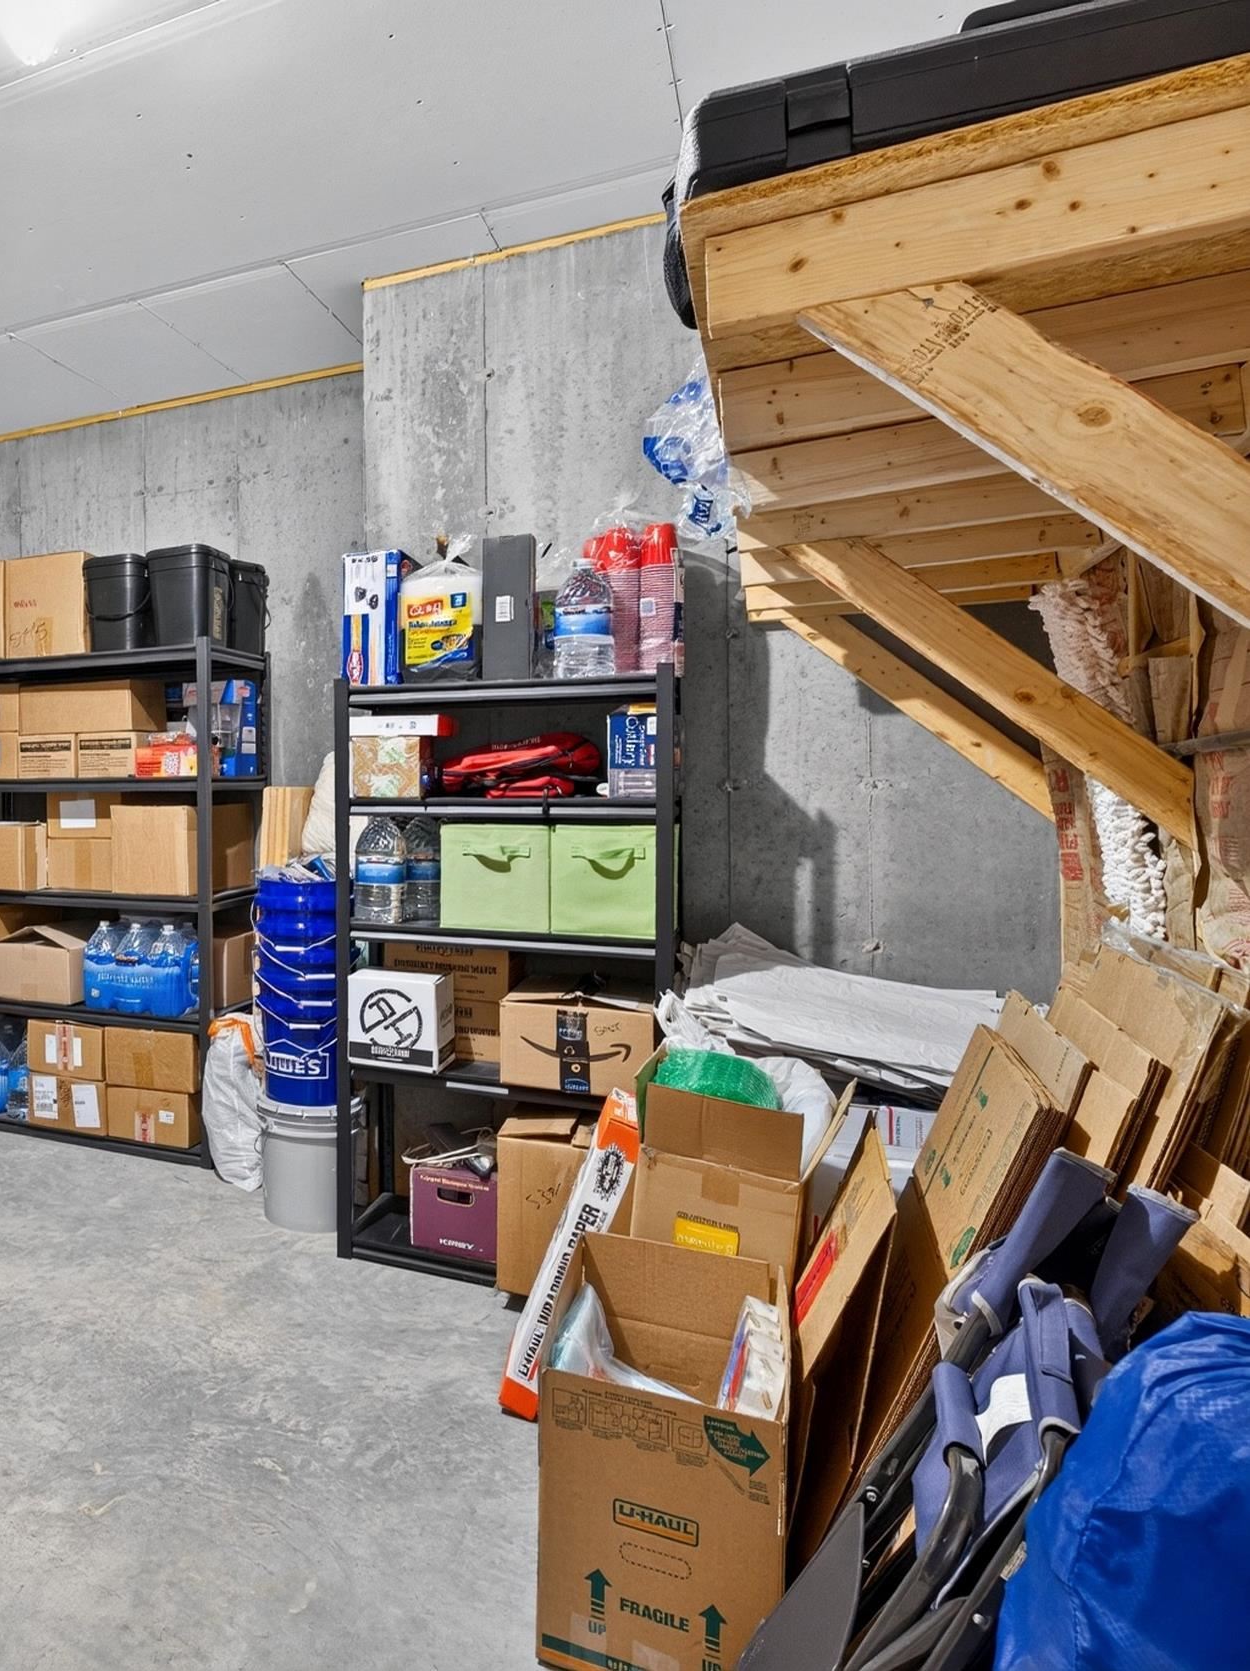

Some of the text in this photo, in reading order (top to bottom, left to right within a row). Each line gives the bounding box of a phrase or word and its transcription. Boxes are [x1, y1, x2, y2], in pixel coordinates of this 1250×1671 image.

[568, 1202, 601, 1251] PAPER
[618, 1504, 695, 1536] U-HAUL
[588, 1620, 607, 1635] UP
[619, 1596, 690, 1633] FRAGILE
